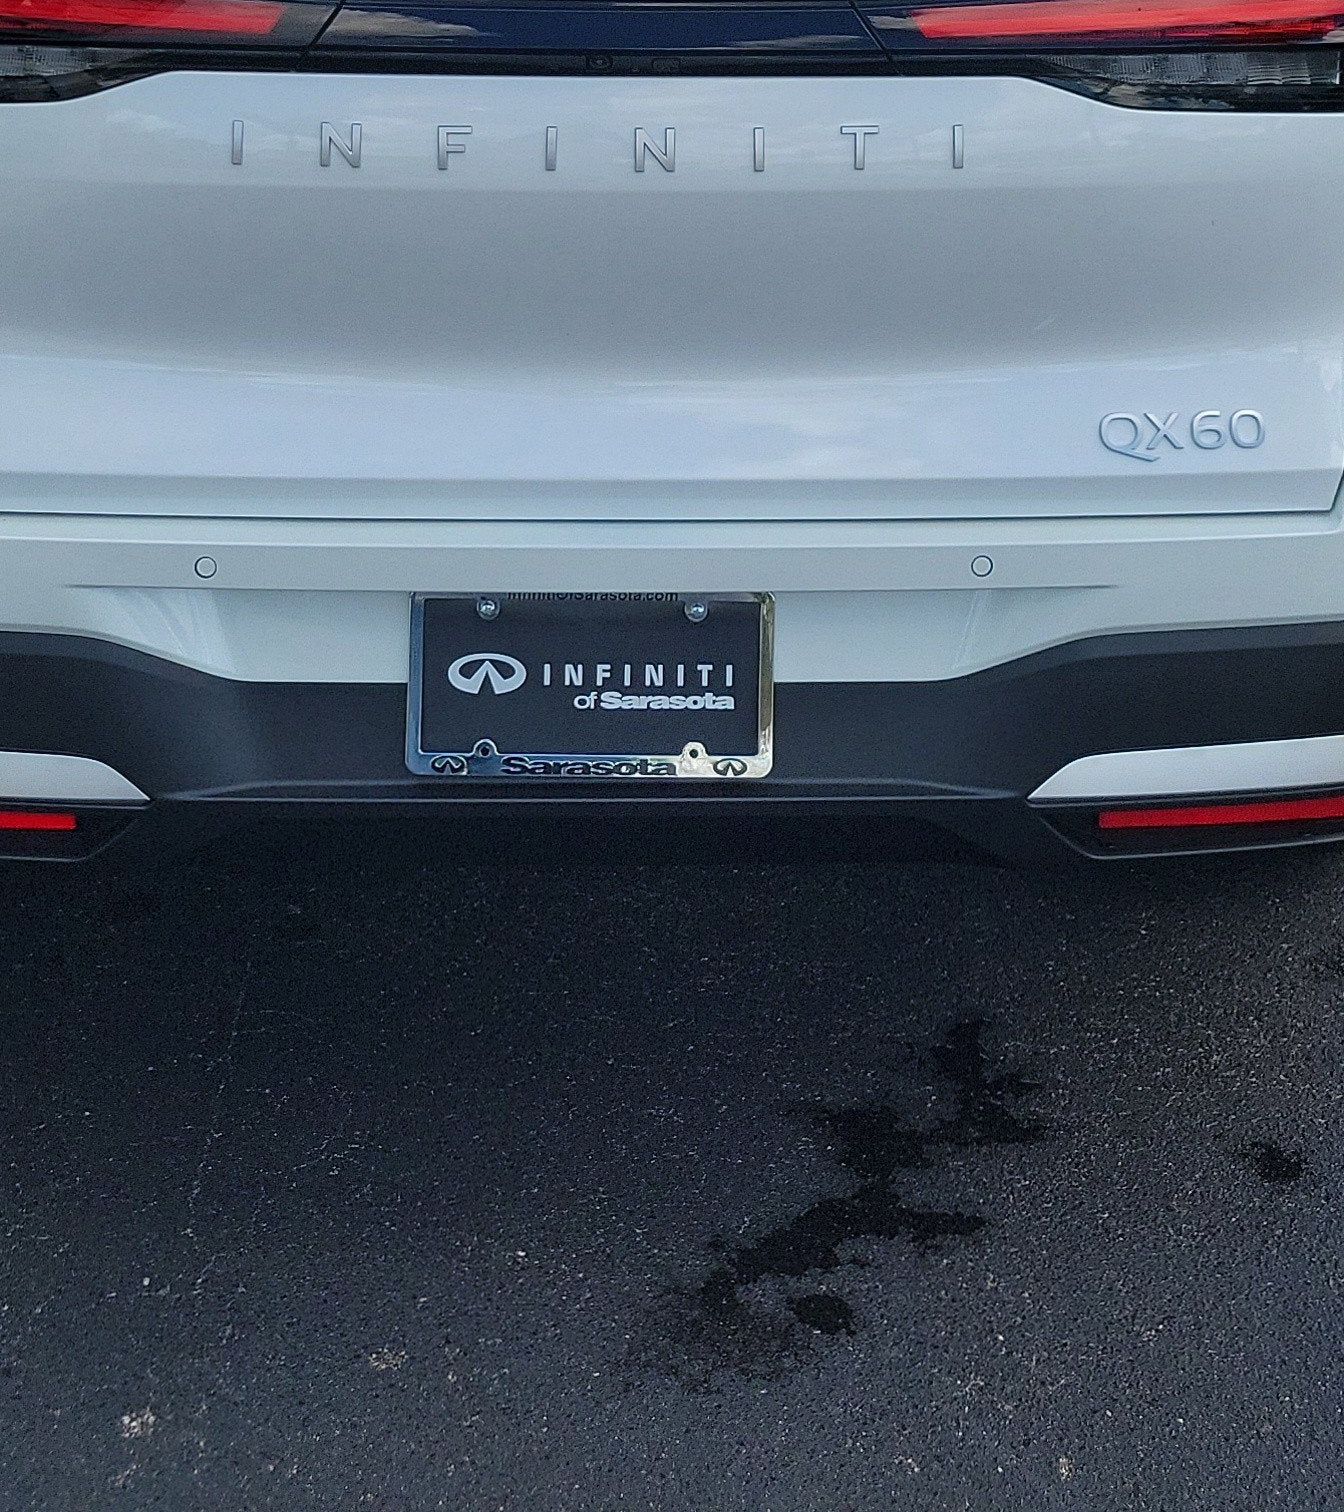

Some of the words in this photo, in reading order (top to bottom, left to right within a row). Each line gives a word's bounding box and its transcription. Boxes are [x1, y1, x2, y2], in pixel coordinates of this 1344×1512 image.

[231, 119, 965, 173] INFINITI
[1099, 409, 1265, 462] QX60
[542, 663, 734, 686] INFINITI
[573, 691, 598, 710] of
[600, 691, 735, 710] Sarasota
[501, 756, 678, 776] Sarasota
